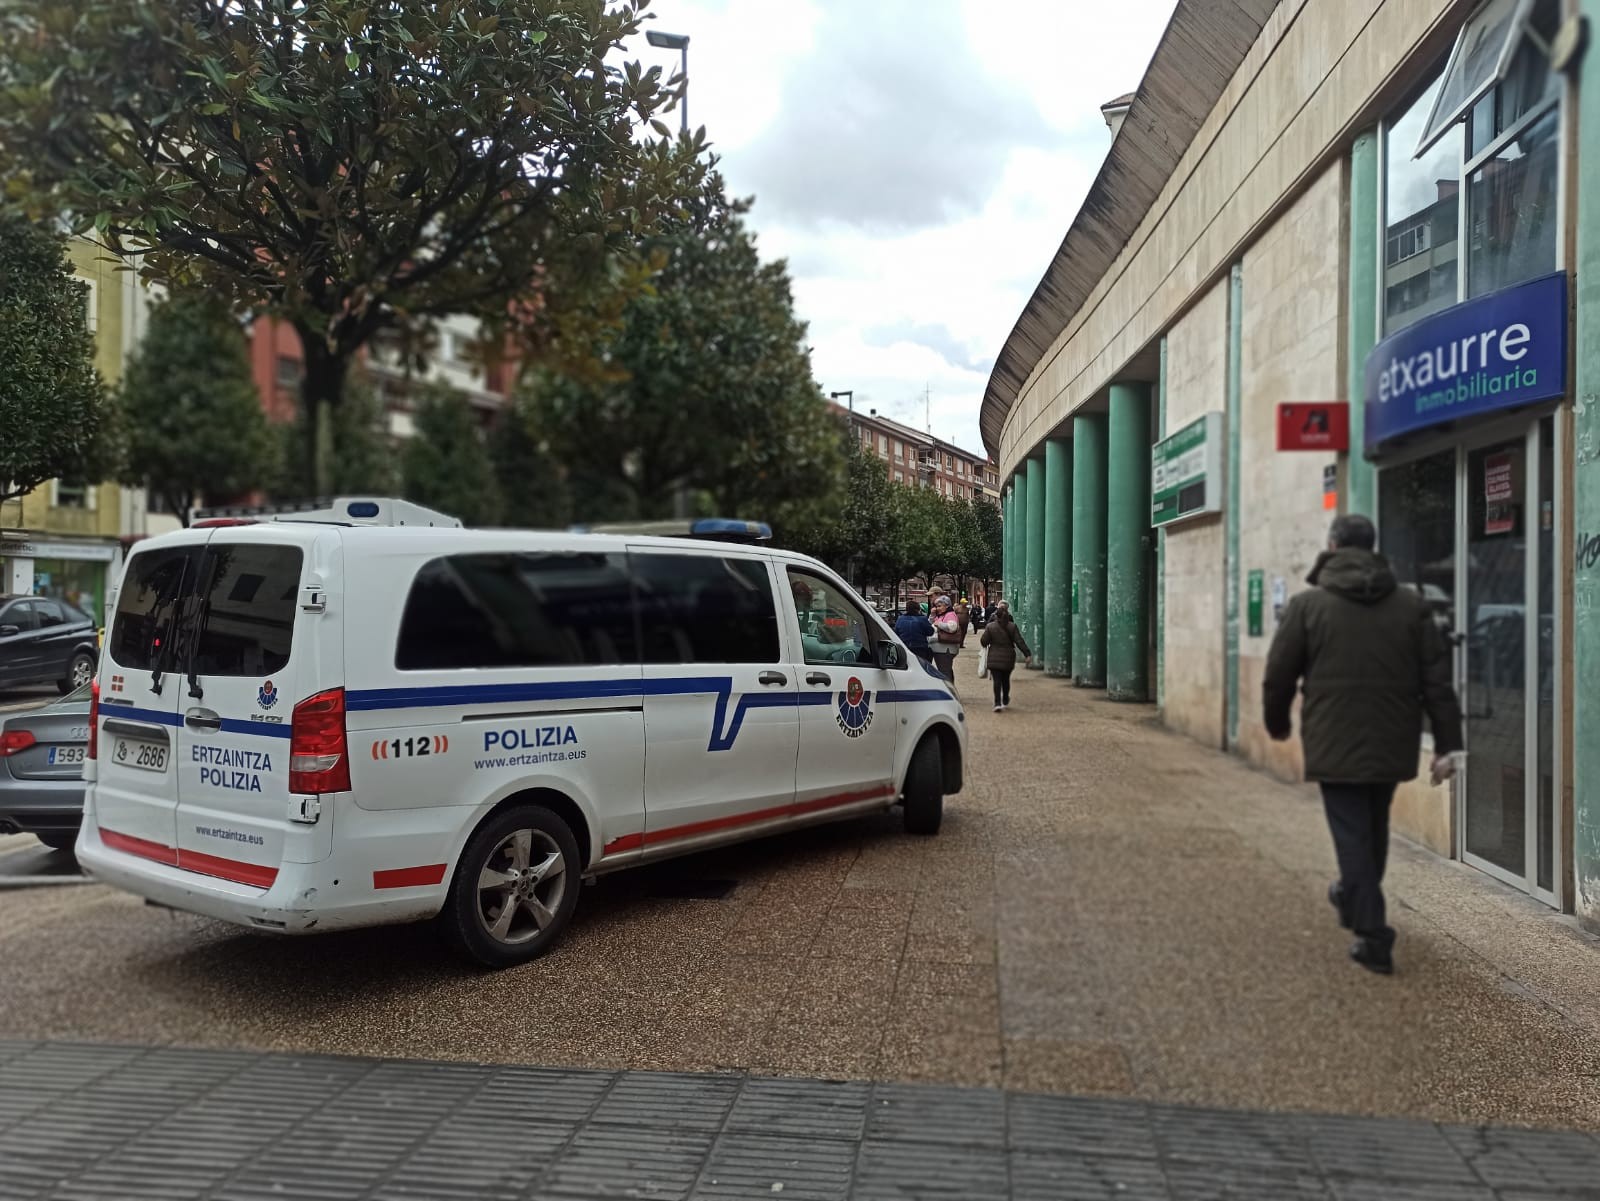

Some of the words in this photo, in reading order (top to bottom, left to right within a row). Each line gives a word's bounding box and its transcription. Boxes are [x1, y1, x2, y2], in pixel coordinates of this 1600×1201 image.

[1379, 323, 1531, 403] etxaurre
[1416, 365, 1537, 414] inmobiliaria
[836, 711, 874, 738] ERTZAINTZA
[391, 737, 430, 758] 112
[484, 725, 578, 751] POLIZIA
[58, 748, 88, 763] 593
[136, 745, 166, 768] 2686
[192, 744, 272, 772] ERTZAINTZA
[474, 750, 587, 769] www.ertzaintza.eus
[200, 767, 262, 793] POLIZIA
[196, 826, 264, 846] www.ertzaintza.eus
